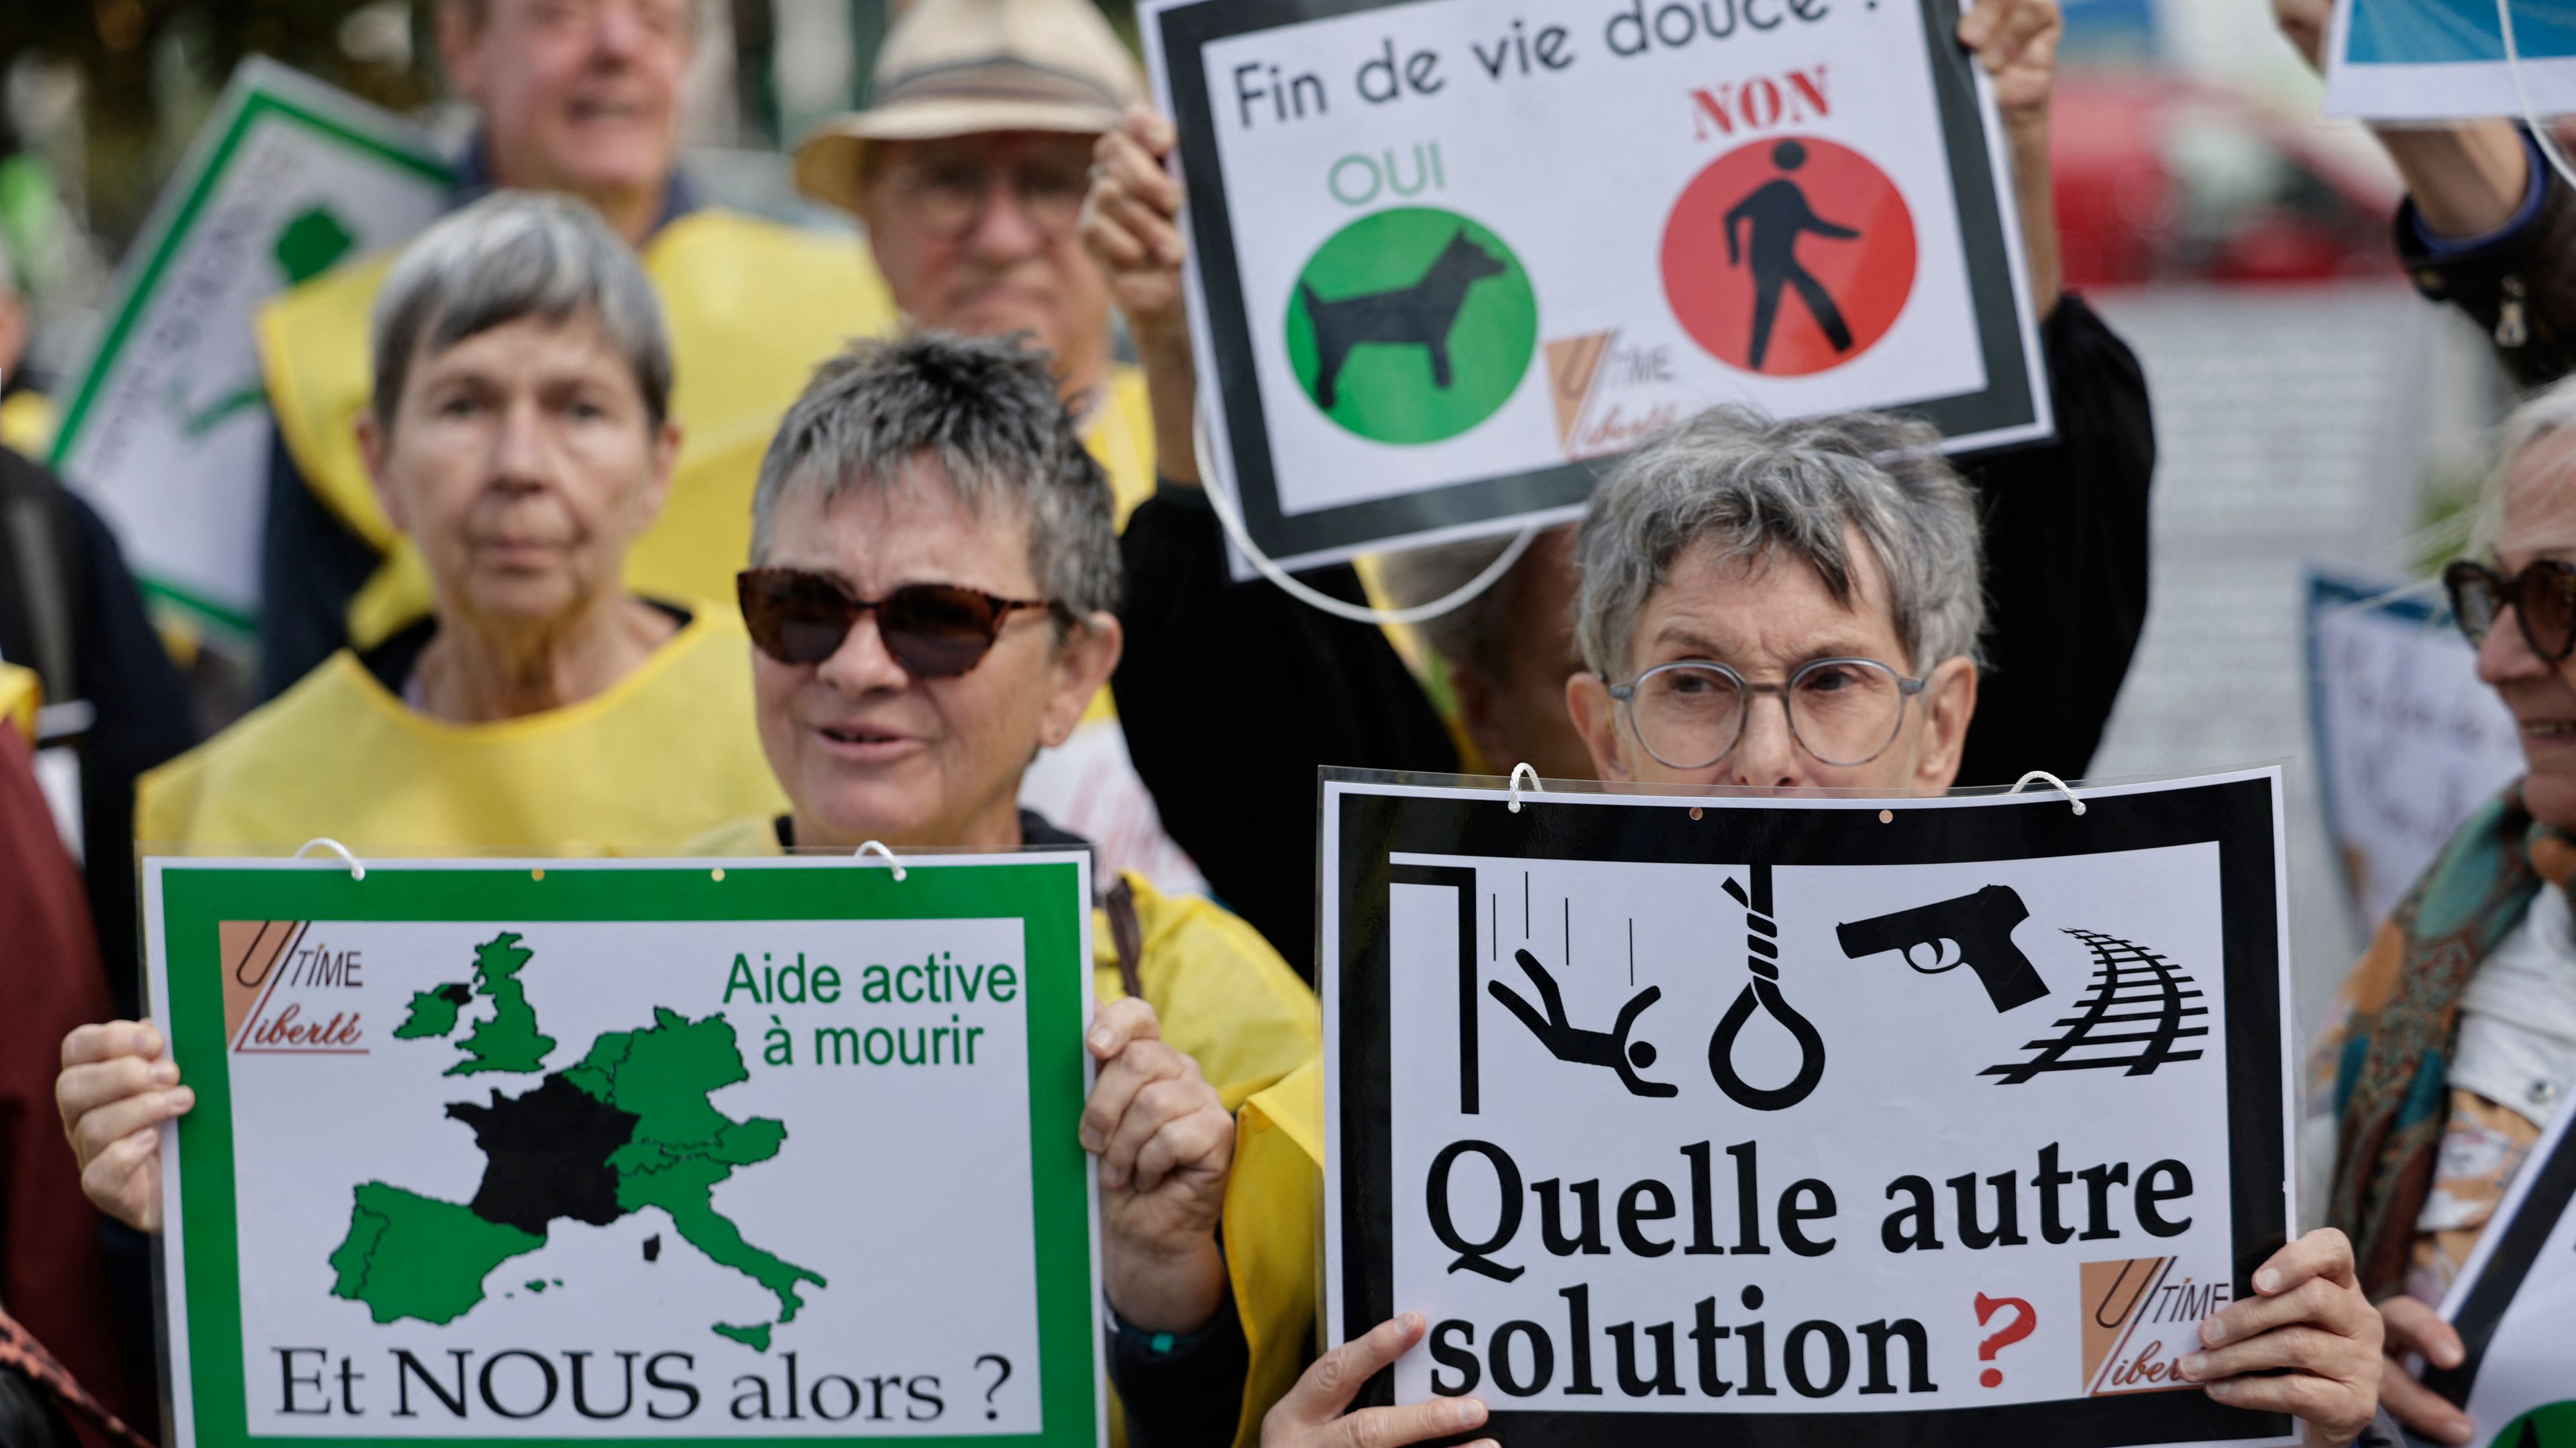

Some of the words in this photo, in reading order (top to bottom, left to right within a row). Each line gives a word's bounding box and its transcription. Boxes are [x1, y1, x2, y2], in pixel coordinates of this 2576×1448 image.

[1233, 62, 1328, 129] Fin
[1355, 37, 1448, 104] de
[1472, 19, 1575, 79] vie
[1689, 65, 1829, 142] NON
[1328, 140, 1446, 207] OUI
[723, 951, 841, 1004] Aide
[861, 953, 1018, 1004] active
[763, 1016, 793, 1066] à
[814, 1015, 985, 1066] mourir
[1425, 1139, 1838, 1282] Quelle
[1880, 1141, 2195, 1254] autre
[1428, 1283, 1939, 1399] solution
[1974, 1290, 2037, 1389] ?
[274, 1347, 364, 1416] Et
[389, 1347, 701, 1420] NOUS
[729, 1350, 945, 1420] alors
[974, 1353, 1012, 1420] ?
